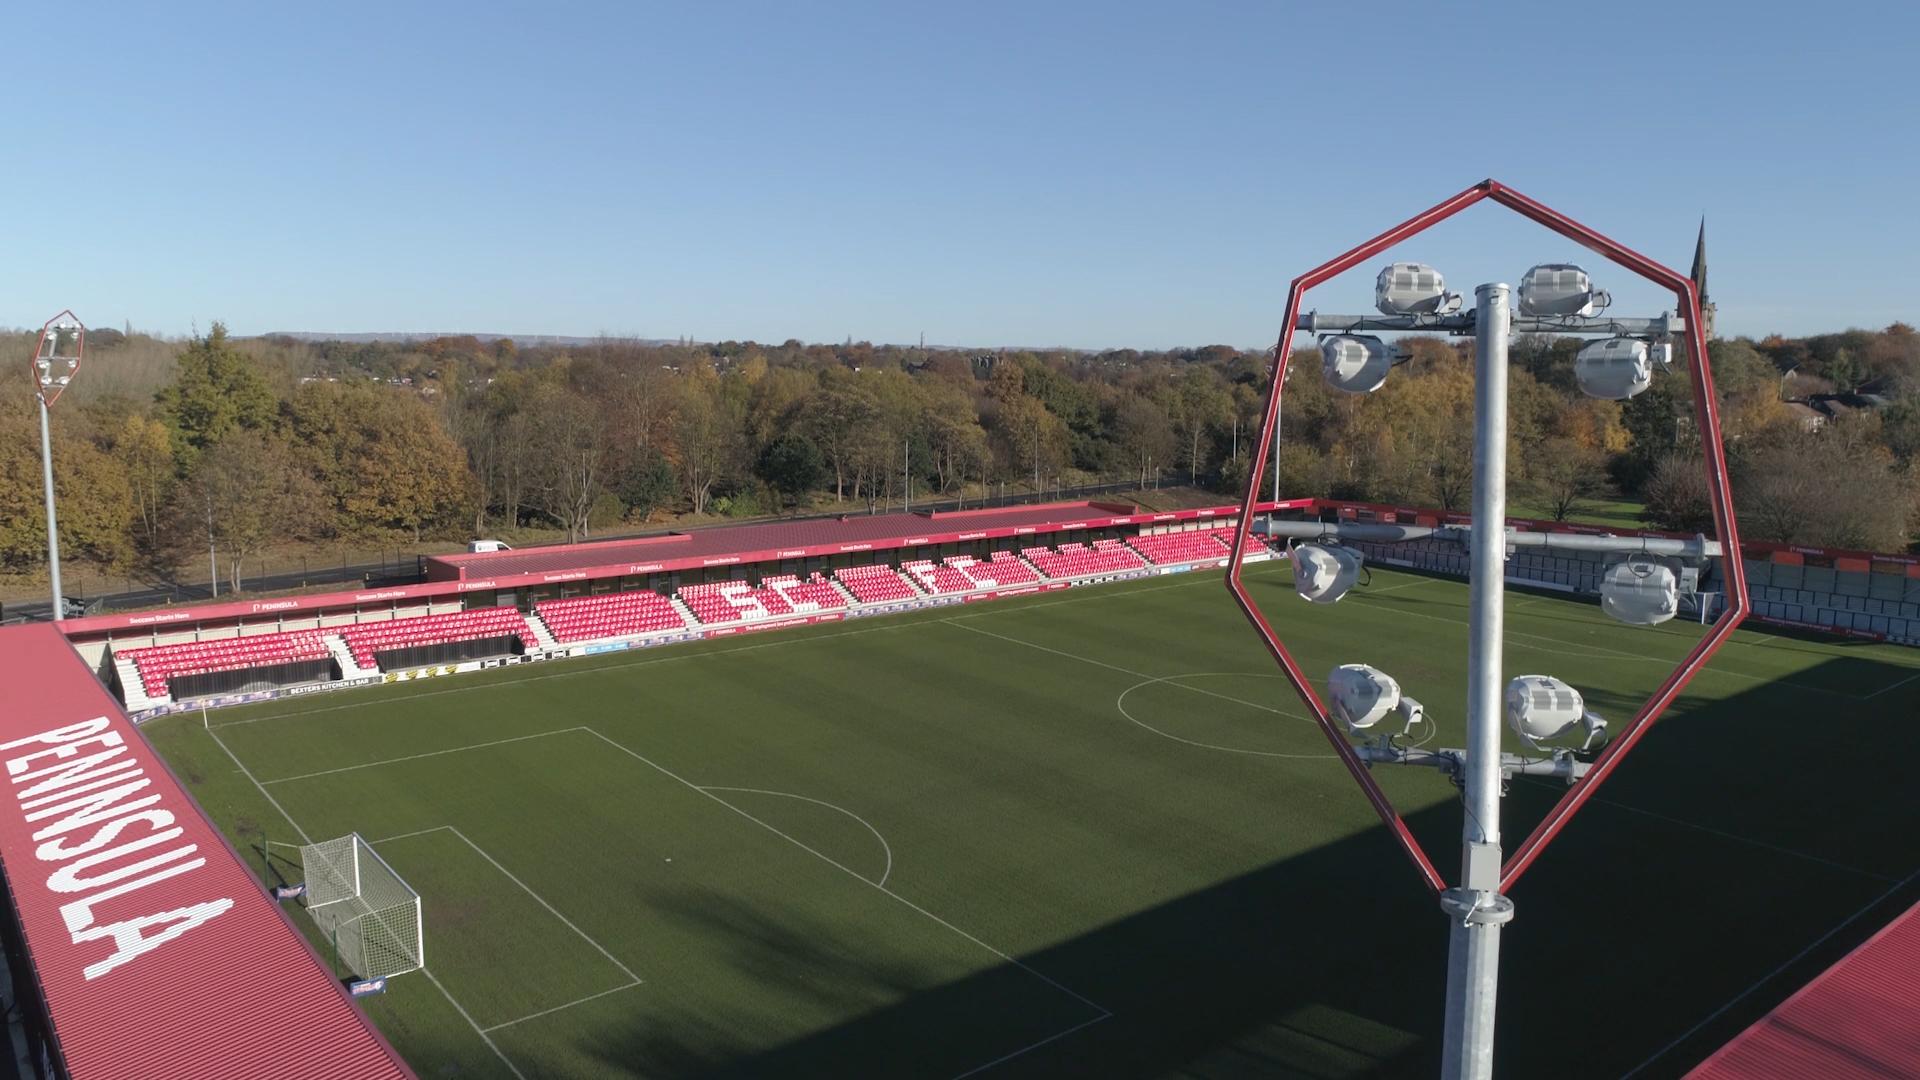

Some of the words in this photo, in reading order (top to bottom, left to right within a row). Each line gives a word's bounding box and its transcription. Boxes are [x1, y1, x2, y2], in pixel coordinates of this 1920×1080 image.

[262, 601, 298, 610] PENINSULA
[322, 681, 349, 690] KITCHEN
[0, 716, 234, 981] PENINSULA
